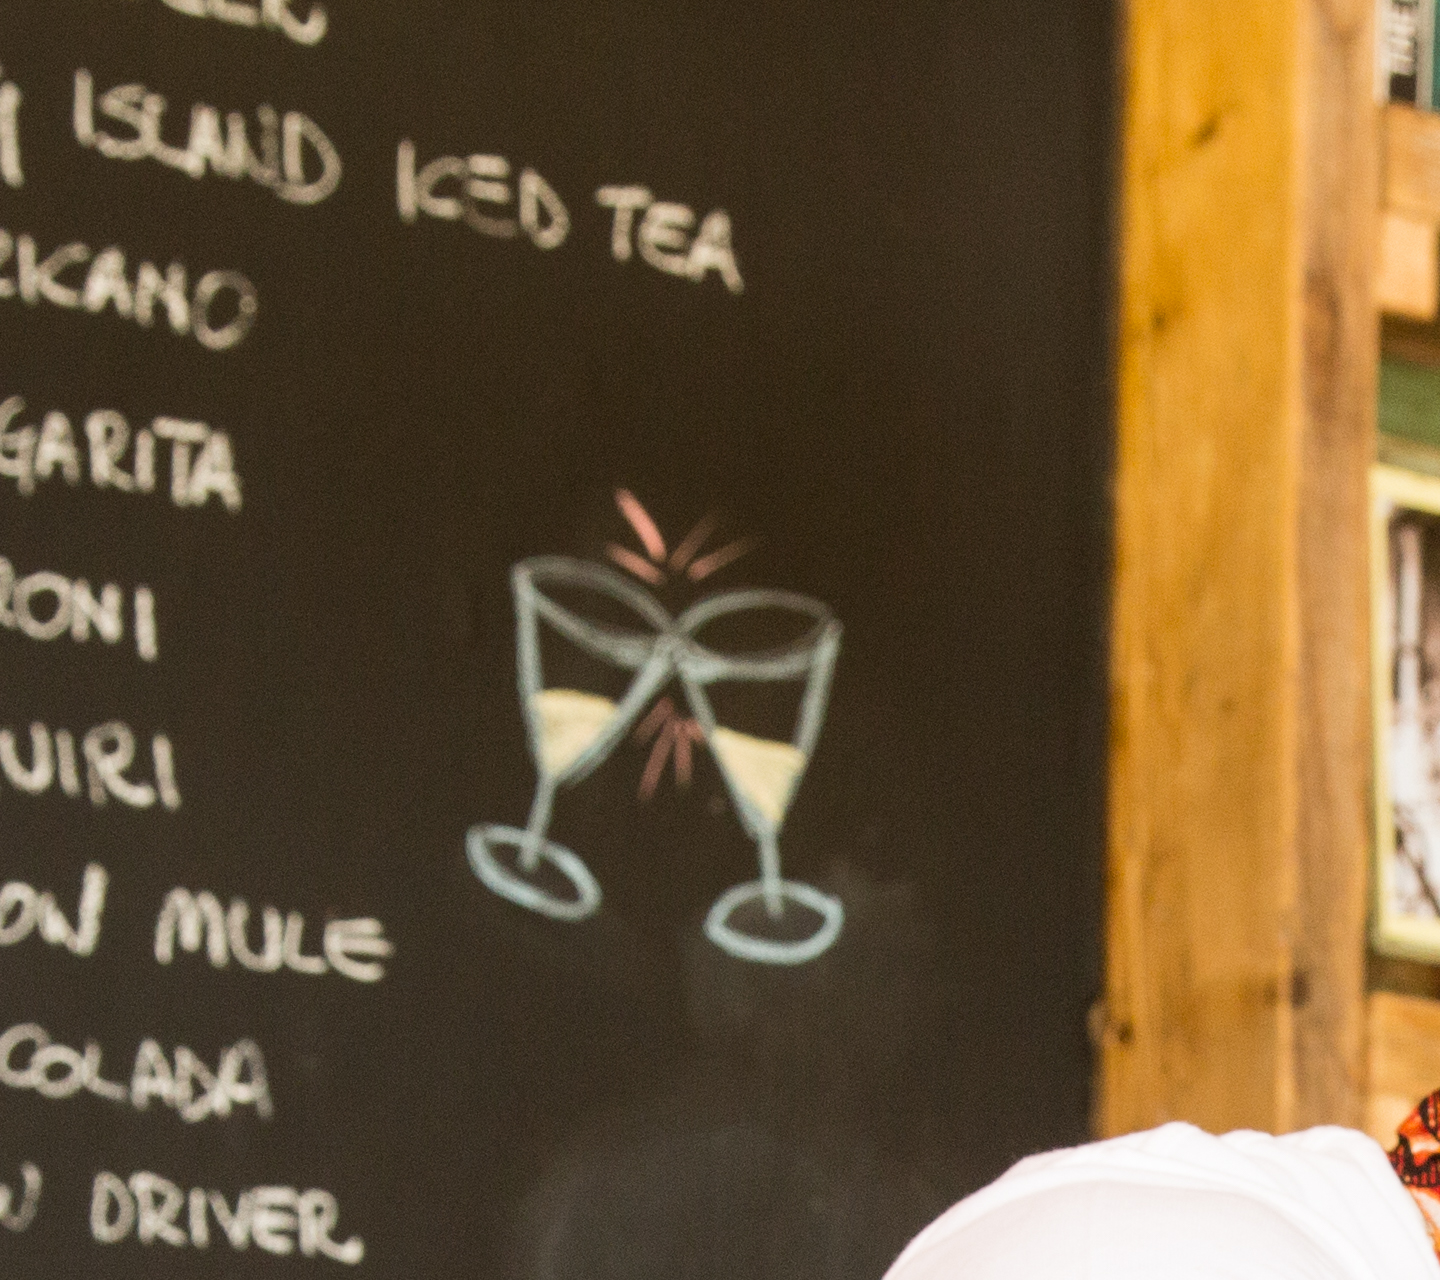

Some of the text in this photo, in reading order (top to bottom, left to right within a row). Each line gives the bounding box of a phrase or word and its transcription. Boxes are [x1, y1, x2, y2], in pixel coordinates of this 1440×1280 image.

[70, 68, 343, 206] ISLAND
[394, 139, 571, 251] ICED
[595, 183, 744, 291] TEA
[151, 885, 393, 985] MULE
[88, 1169, 366, 1266] DRIVER
